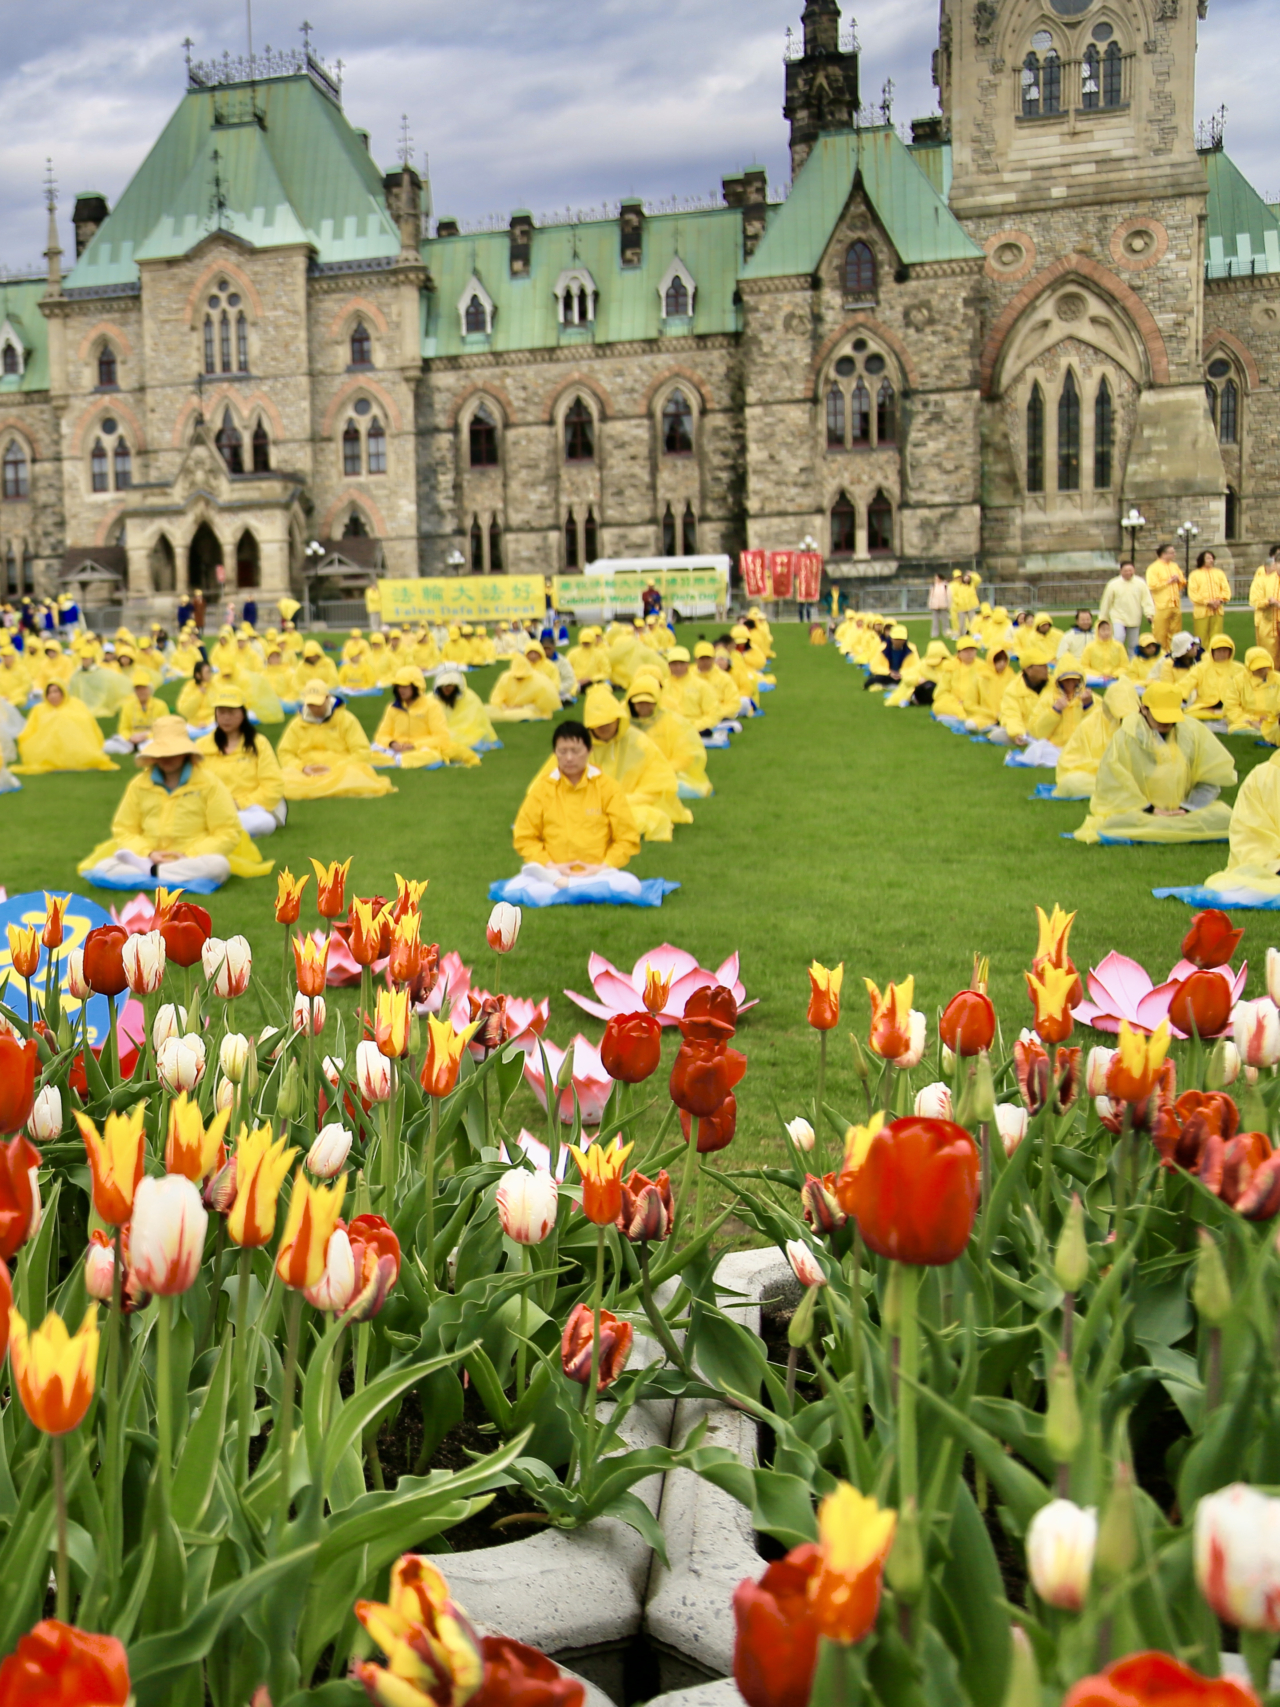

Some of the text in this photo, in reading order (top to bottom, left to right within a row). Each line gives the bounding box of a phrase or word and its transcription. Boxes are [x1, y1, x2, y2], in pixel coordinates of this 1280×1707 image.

[392, 583, 536, 603] 法輪大法好
[394, 603, 536, 617] Falun Dafa is Great
